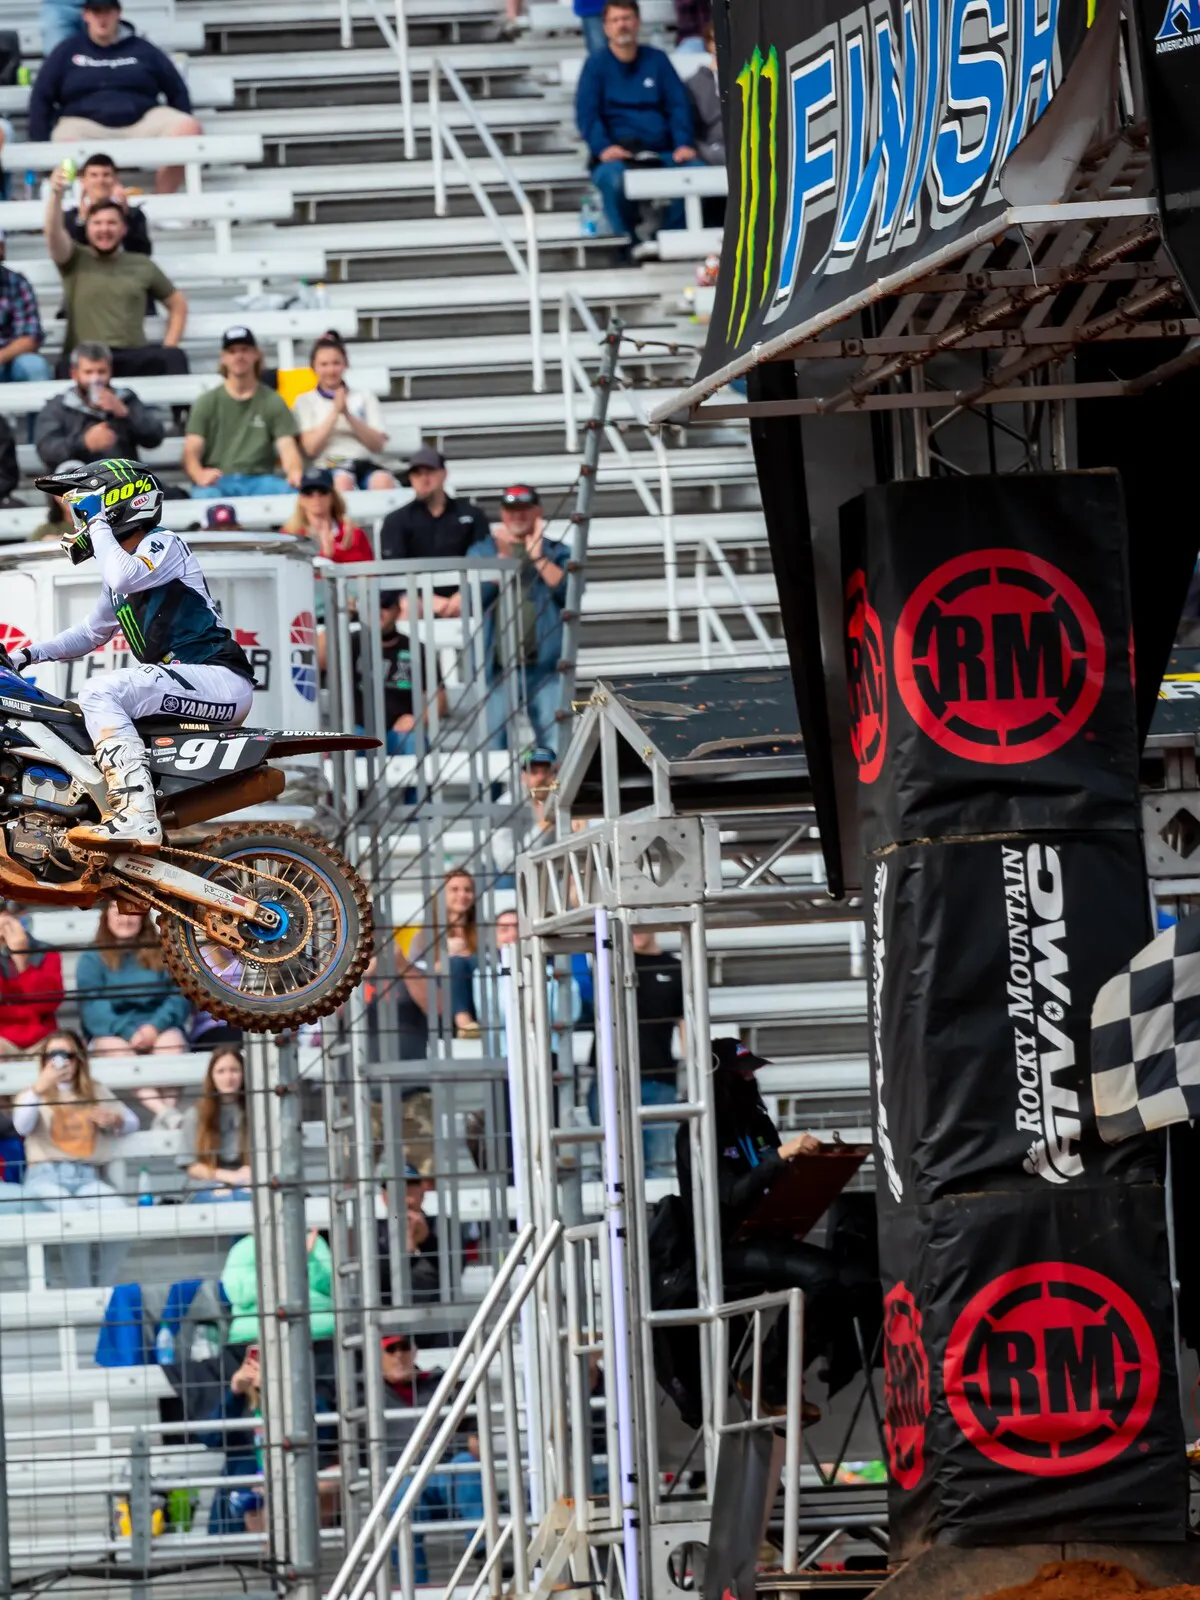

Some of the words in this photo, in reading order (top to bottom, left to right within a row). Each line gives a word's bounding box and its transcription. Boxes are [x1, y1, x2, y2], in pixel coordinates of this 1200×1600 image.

[1156, 36, 1194, 54] AMERICAN
[133, 496, 149, 507] BELL
[934, 610, 1064, 702] RM
[1, 698, 32, 712] YAMALUBE
[179, 699, 234, 721] YAMAHA
[179, 723, 210, 732] YAMAHA
[174, 736, 250, 771] 91
[124, 863, 152, 876] EXCEL
[1001, 844, 1036, 1026] MOUNTAIN
[1014, 1026, 1044, 1136] ROCKY
[984, 1326, 1117, 1417] RM
